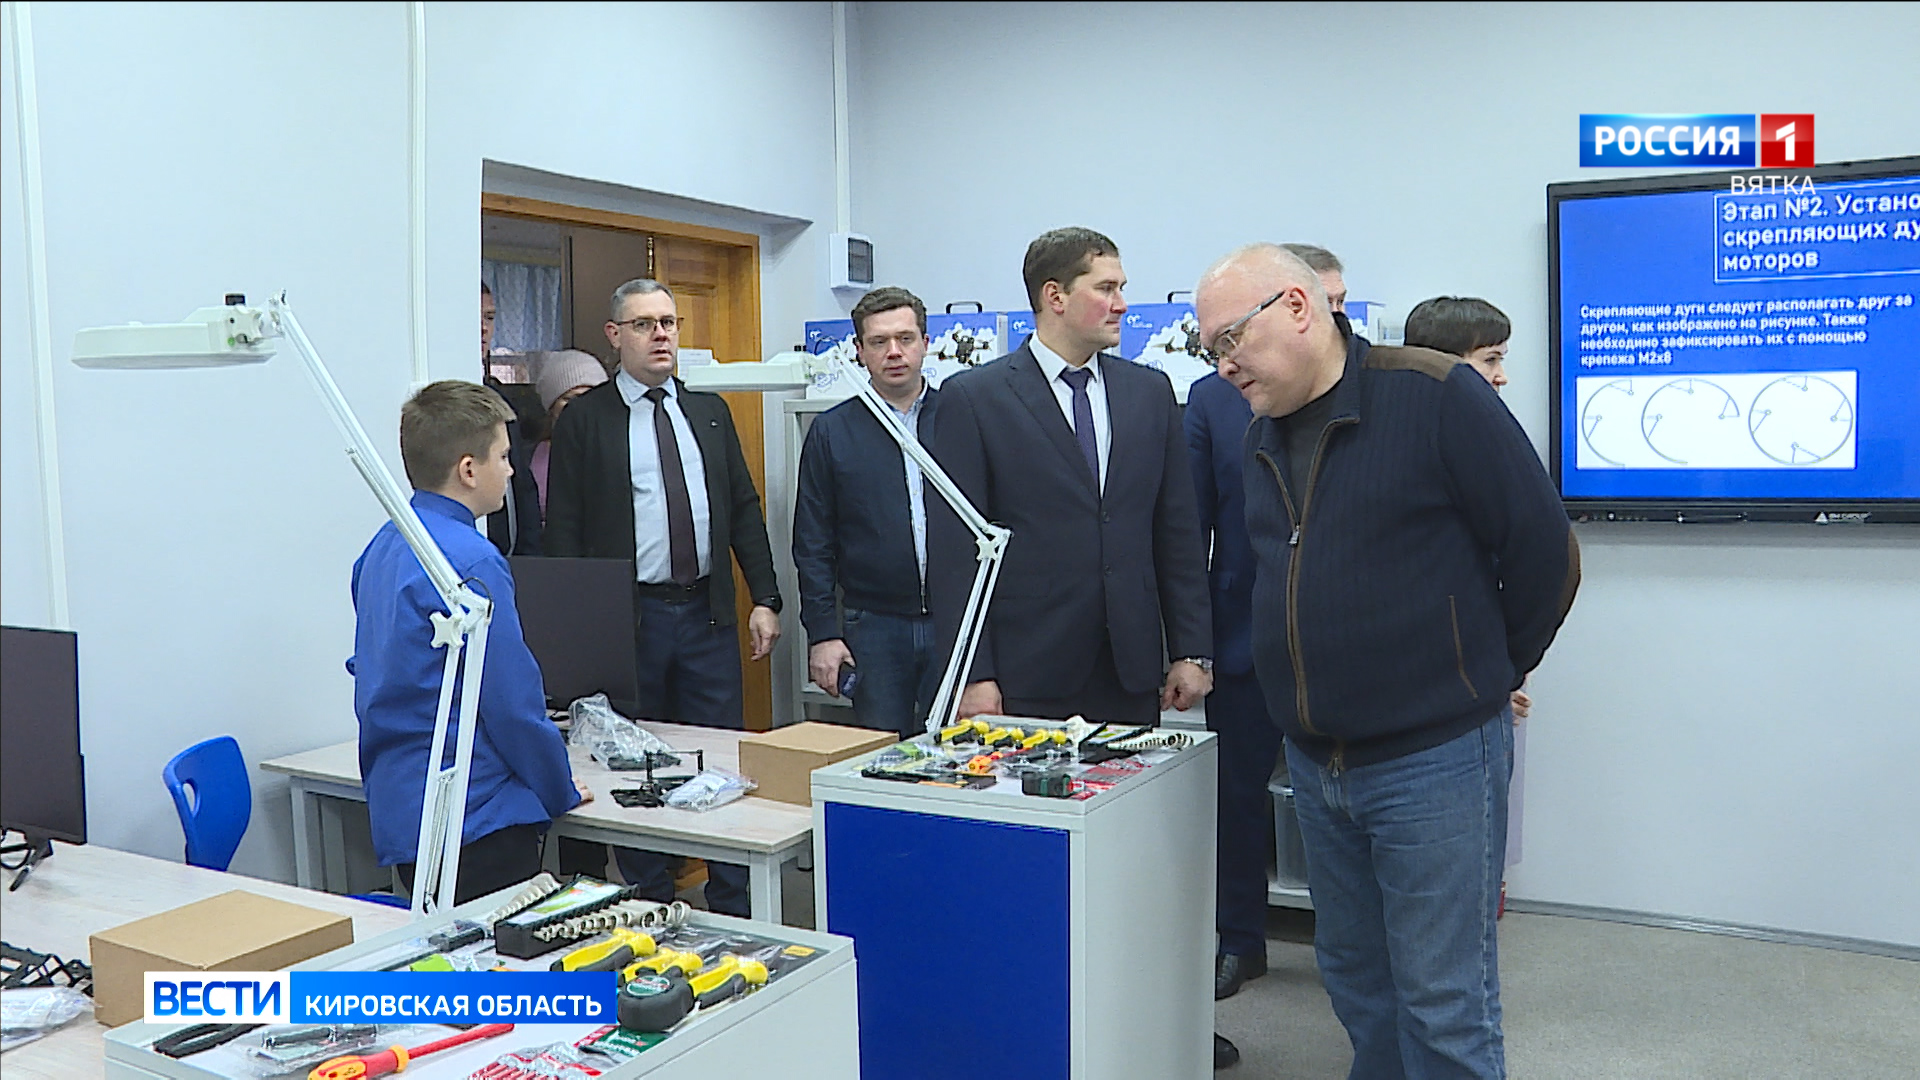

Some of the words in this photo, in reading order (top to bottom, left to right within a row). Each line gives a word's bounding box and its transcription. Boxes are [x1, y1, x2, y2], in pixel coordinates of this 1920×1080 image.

[1722, 201, 1778, 222] Этап
[1784, 196, 1829, 219] №2.
[1835, 193, 1920, 216] Устано
[1722, 221, 1887, 250] скрепляющих
[1722, 251, 1819, 274] моторов
[1580, 304, 1672, 321] Скрепляющие
[1674, 303, 1706, 320] дуги
[1708, 300, 1763, 317] следует
[1766, 297, 1855, 315] располагать
[1857, 295, 1892, 311] друг
[1895, 294, 1913, 307] за
[1580, 322, 1629, 337] другом,
[1631, 321, 1655, 333] как
[1657, 317, 1738, 333] изображено
[1740, 317, 1757, 329] на
[1760, 315, 1820, 331] рисунке.
[1822, 312, 1868, 327] Также
[1580, 336, 1659, 351] необходимо
[1660, 333, 1764, 349] зафиксировать
[1766, 333, 1784, 346] их
[1786, 332, 1796, 344] с
[1797, 330, 1867, 345] помощью
[1580, 353, 1636, 368] крепежа
